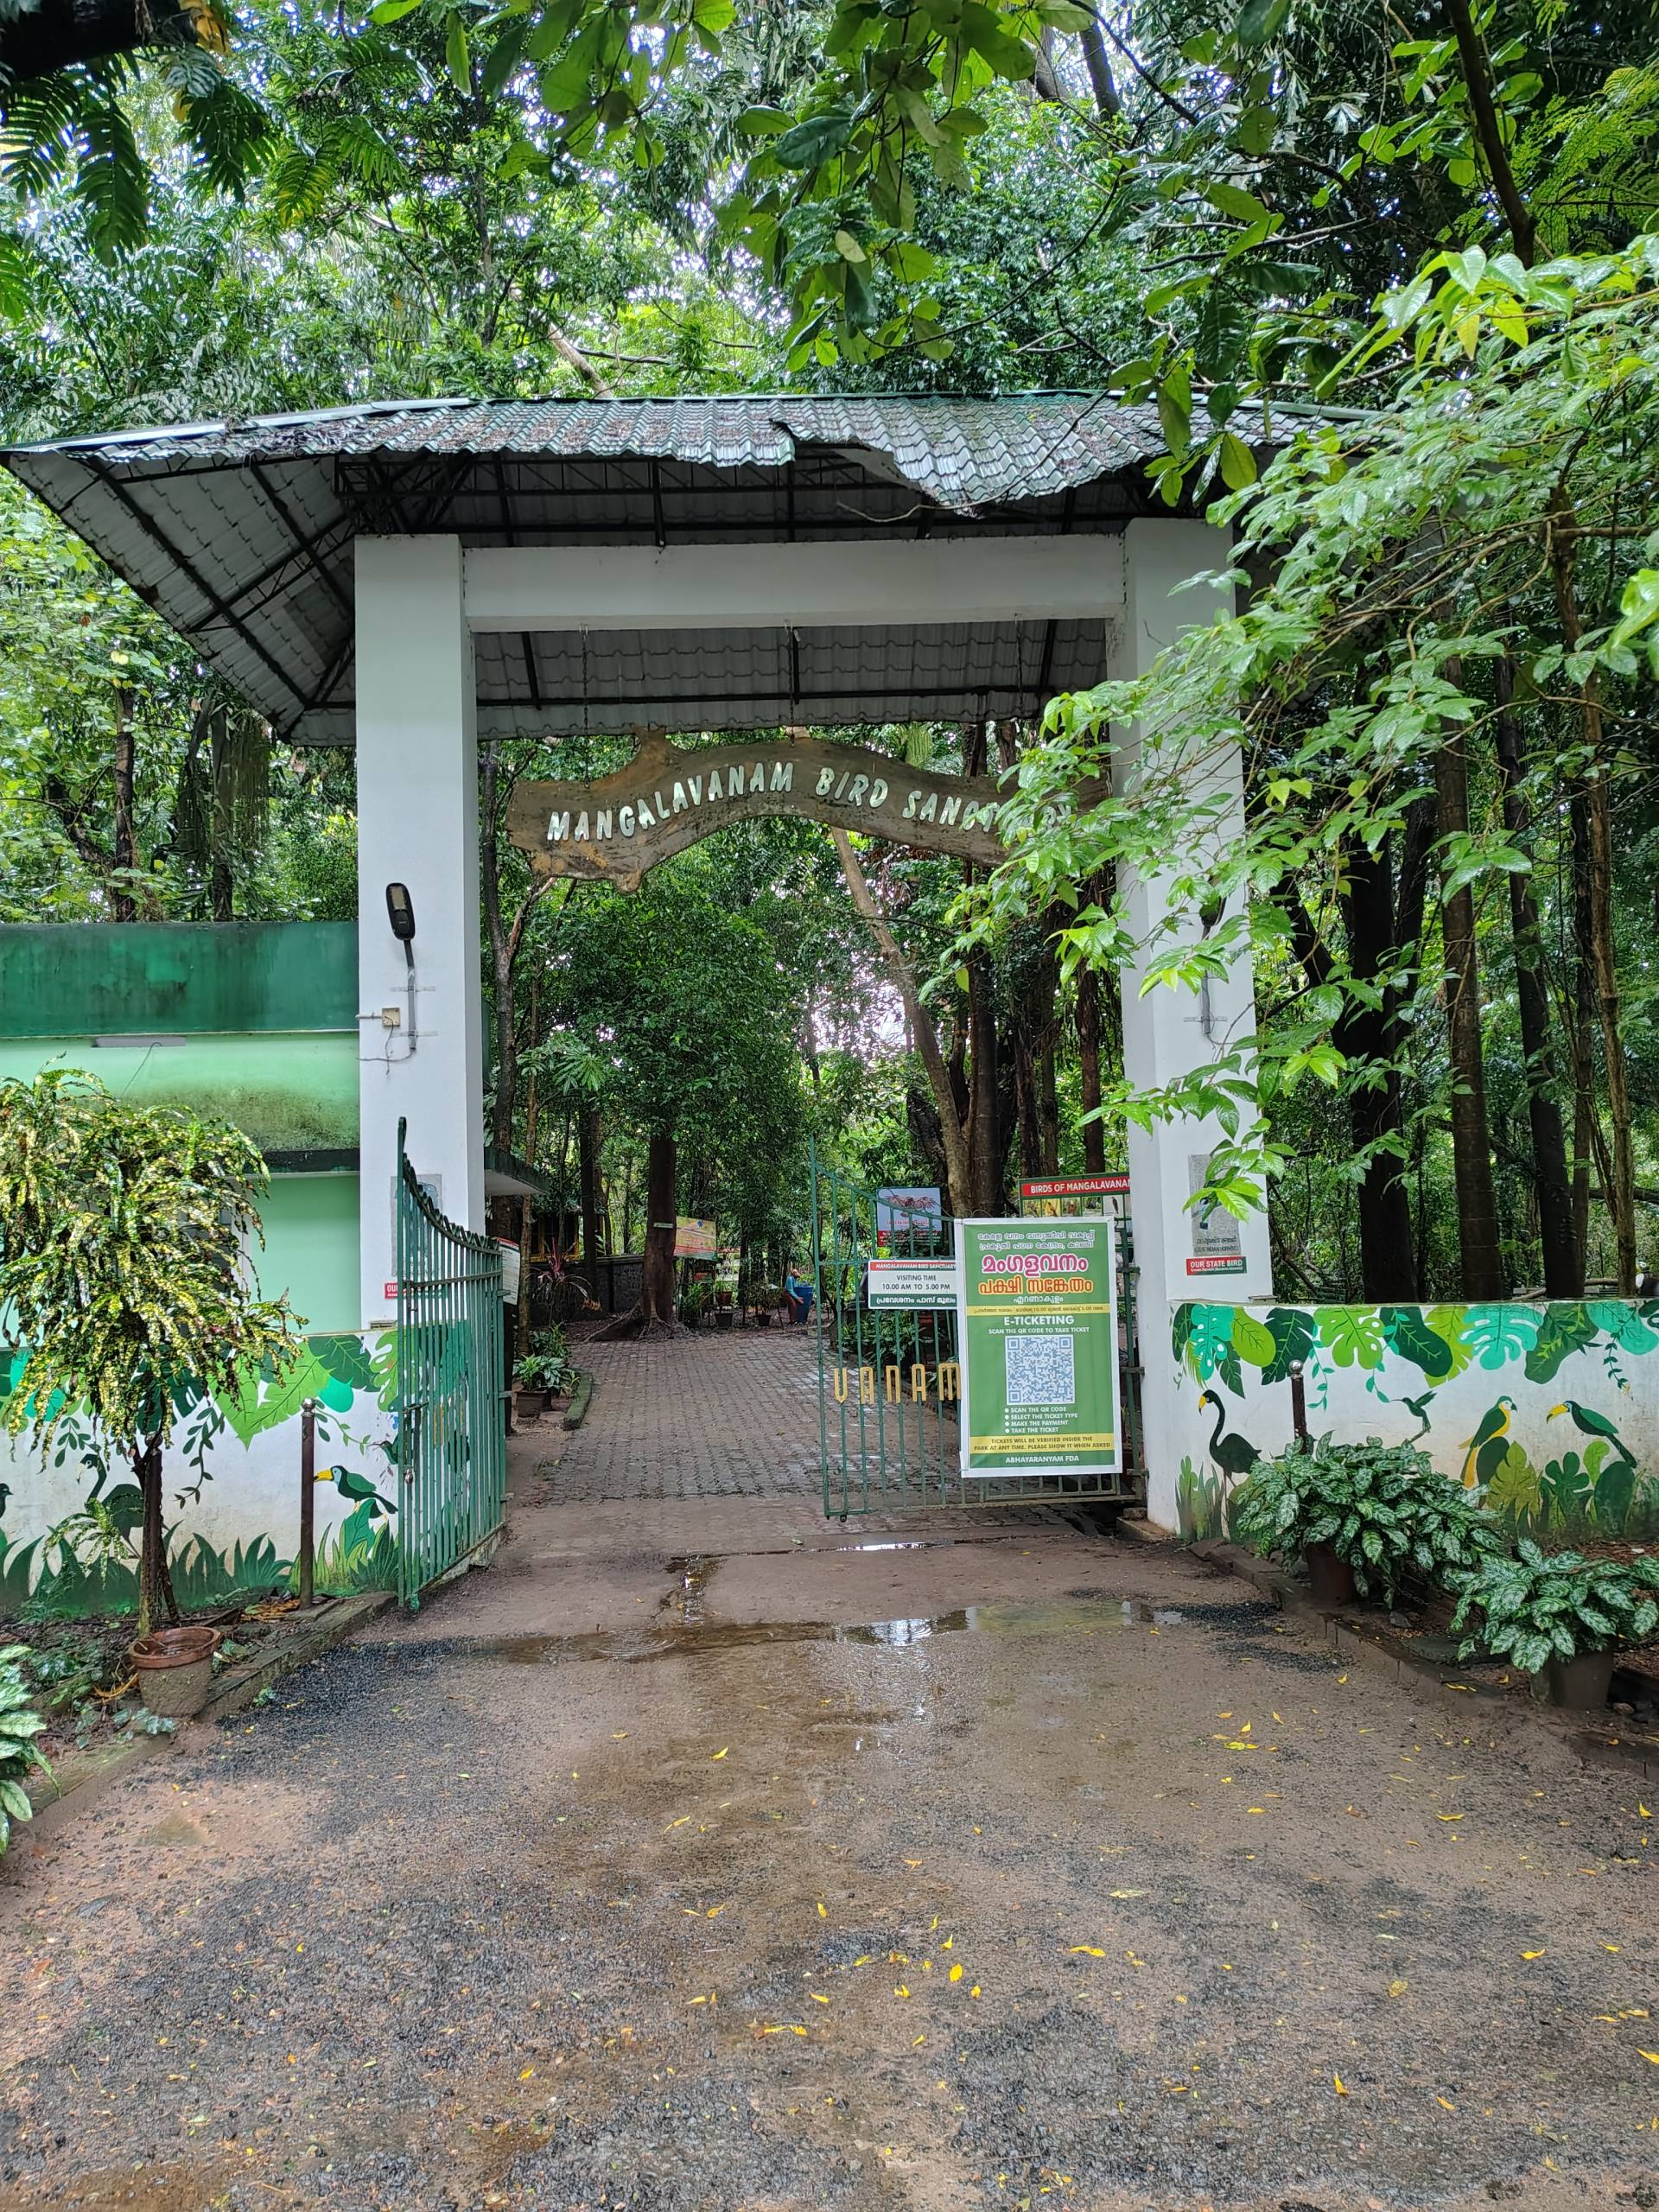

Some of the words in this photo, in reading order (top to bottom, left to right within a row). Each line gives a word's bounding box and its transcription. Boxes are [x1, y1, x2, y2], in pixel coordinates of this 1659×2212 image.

[546, 761, 793, 842] MANGALAVANAM
[815, 766, 888, 808] BIRD
[1030, 1185, 1052, 1194] BIRDS
[1054, 1183, 1065, 1192] OF
[982, 1253, 1089, 1278] മംഗളവനം
[978, 1274, 1023, 1294] പക്ഷി
[1027, 1277, 1094, 1294] സങ്കേതം
[1014, 1295, 1064, 1304] എറണാകുളം
[1004, 1315, 1075, 1326] E-TICKETING
[1005, 1455, 1064, 1464] ABHAYARANYAM
